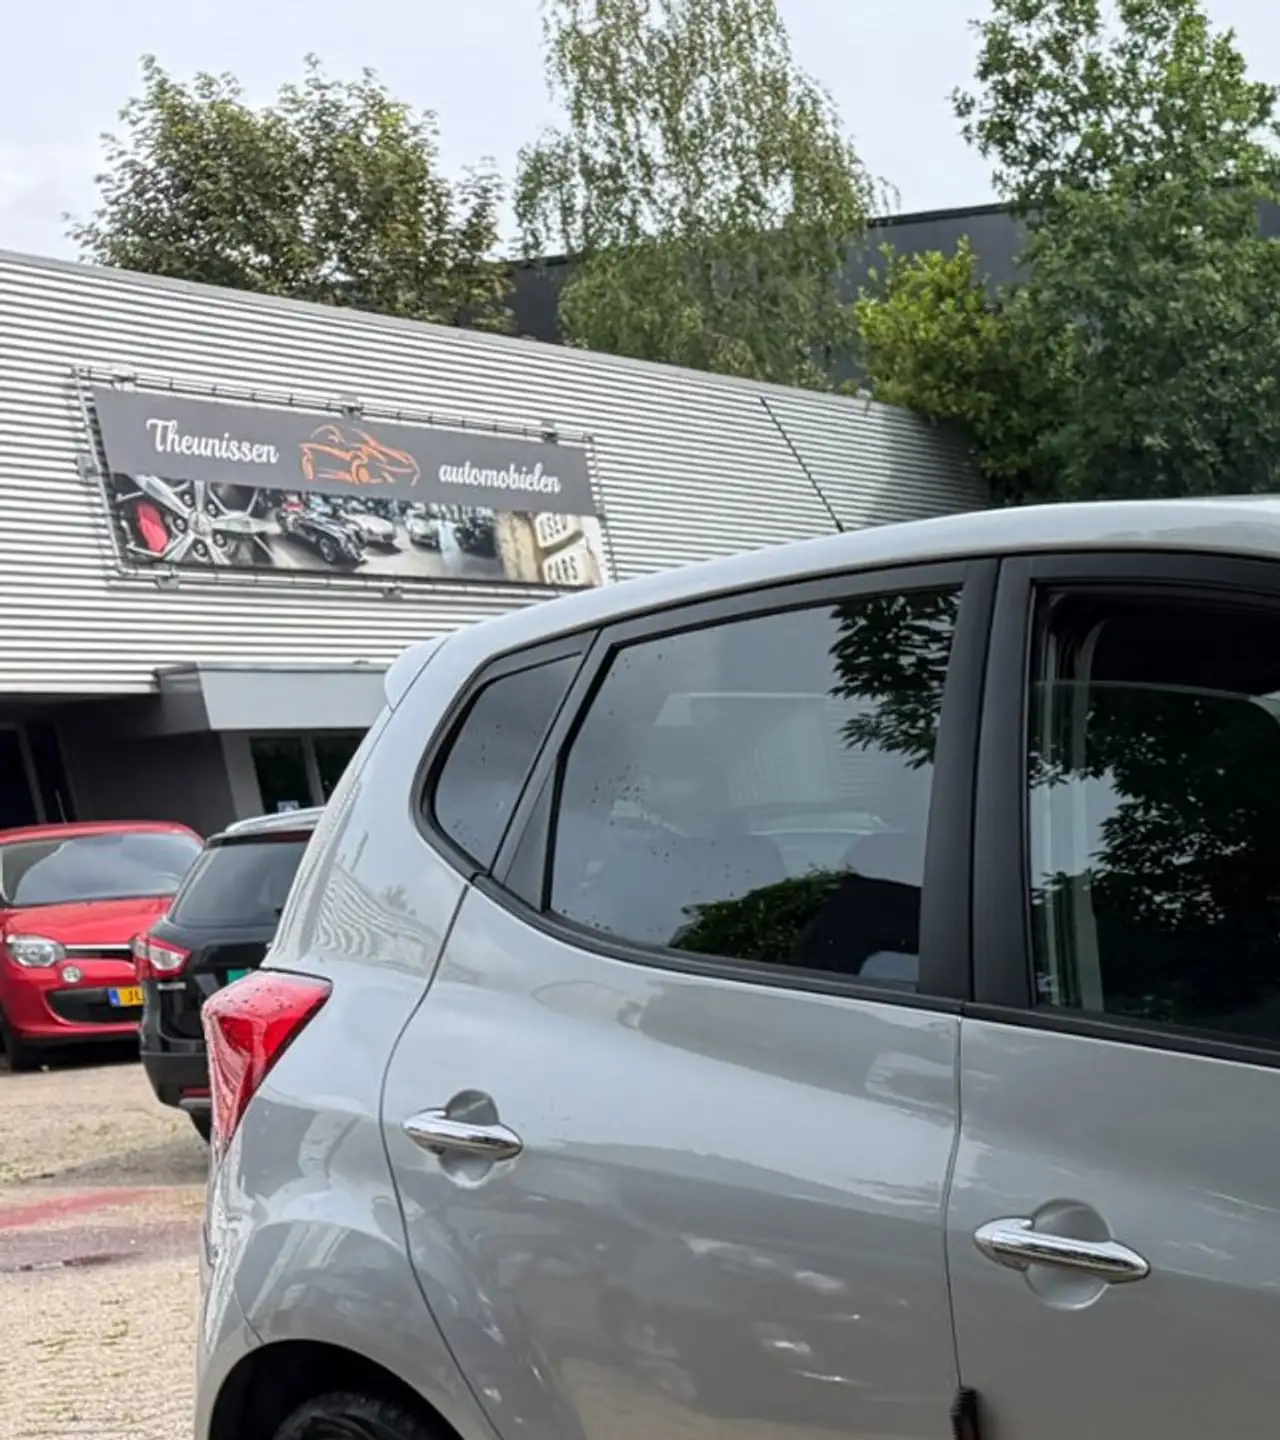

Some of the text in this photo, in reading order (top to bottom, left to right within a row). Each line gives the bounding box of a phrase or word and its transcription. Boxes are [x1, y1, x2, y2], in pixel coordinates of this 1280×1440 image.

[145, 417, 562, 494] Theunissen automobielen
[547, 555, 578, 582] CARS
